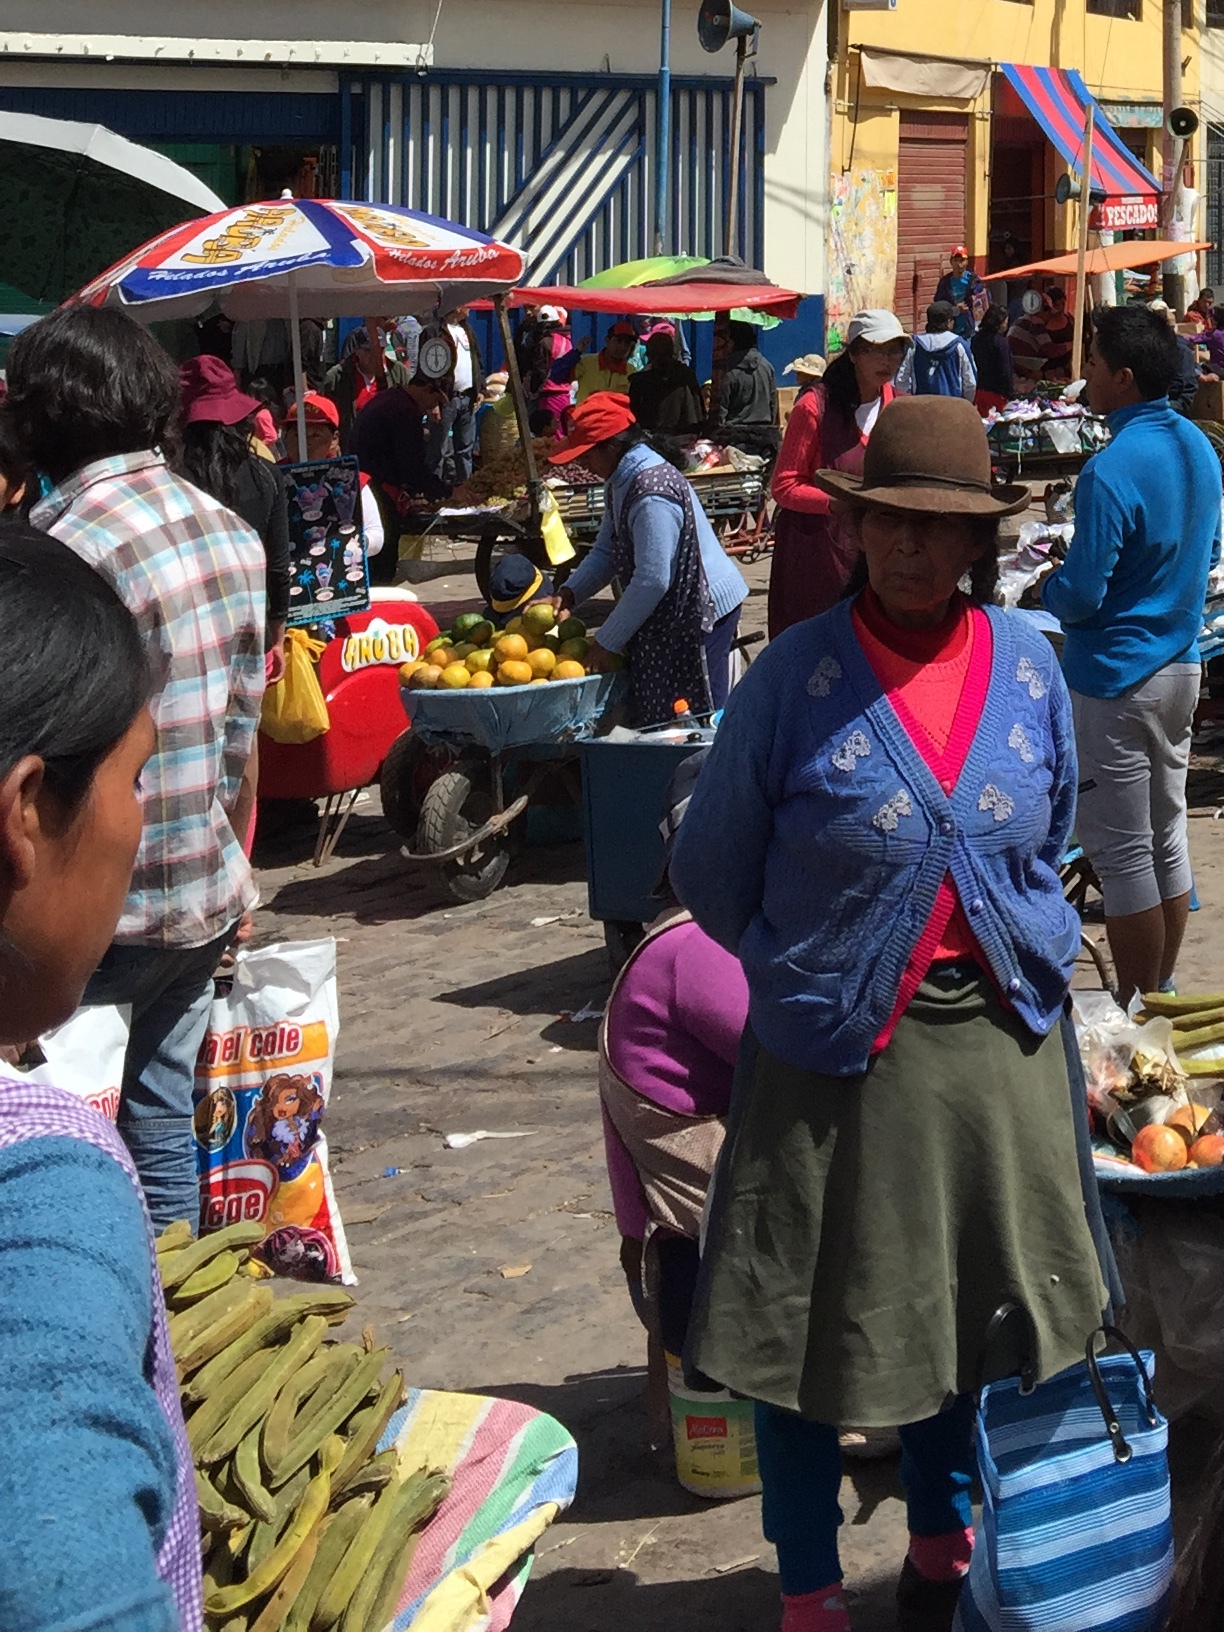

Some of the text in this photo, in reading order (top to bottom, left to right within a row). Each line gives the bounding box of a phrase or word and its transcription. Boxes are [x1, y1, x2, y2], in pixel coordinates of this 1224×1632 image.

[147, 251, 331, 281] Helados Aruba
[385, 247, 500, 271] Helados Aruba
[344, 627, 417, 670] ARUBA
[222, 1032, 242, 1063] el
[249, 1025, 300, 1058] cole
